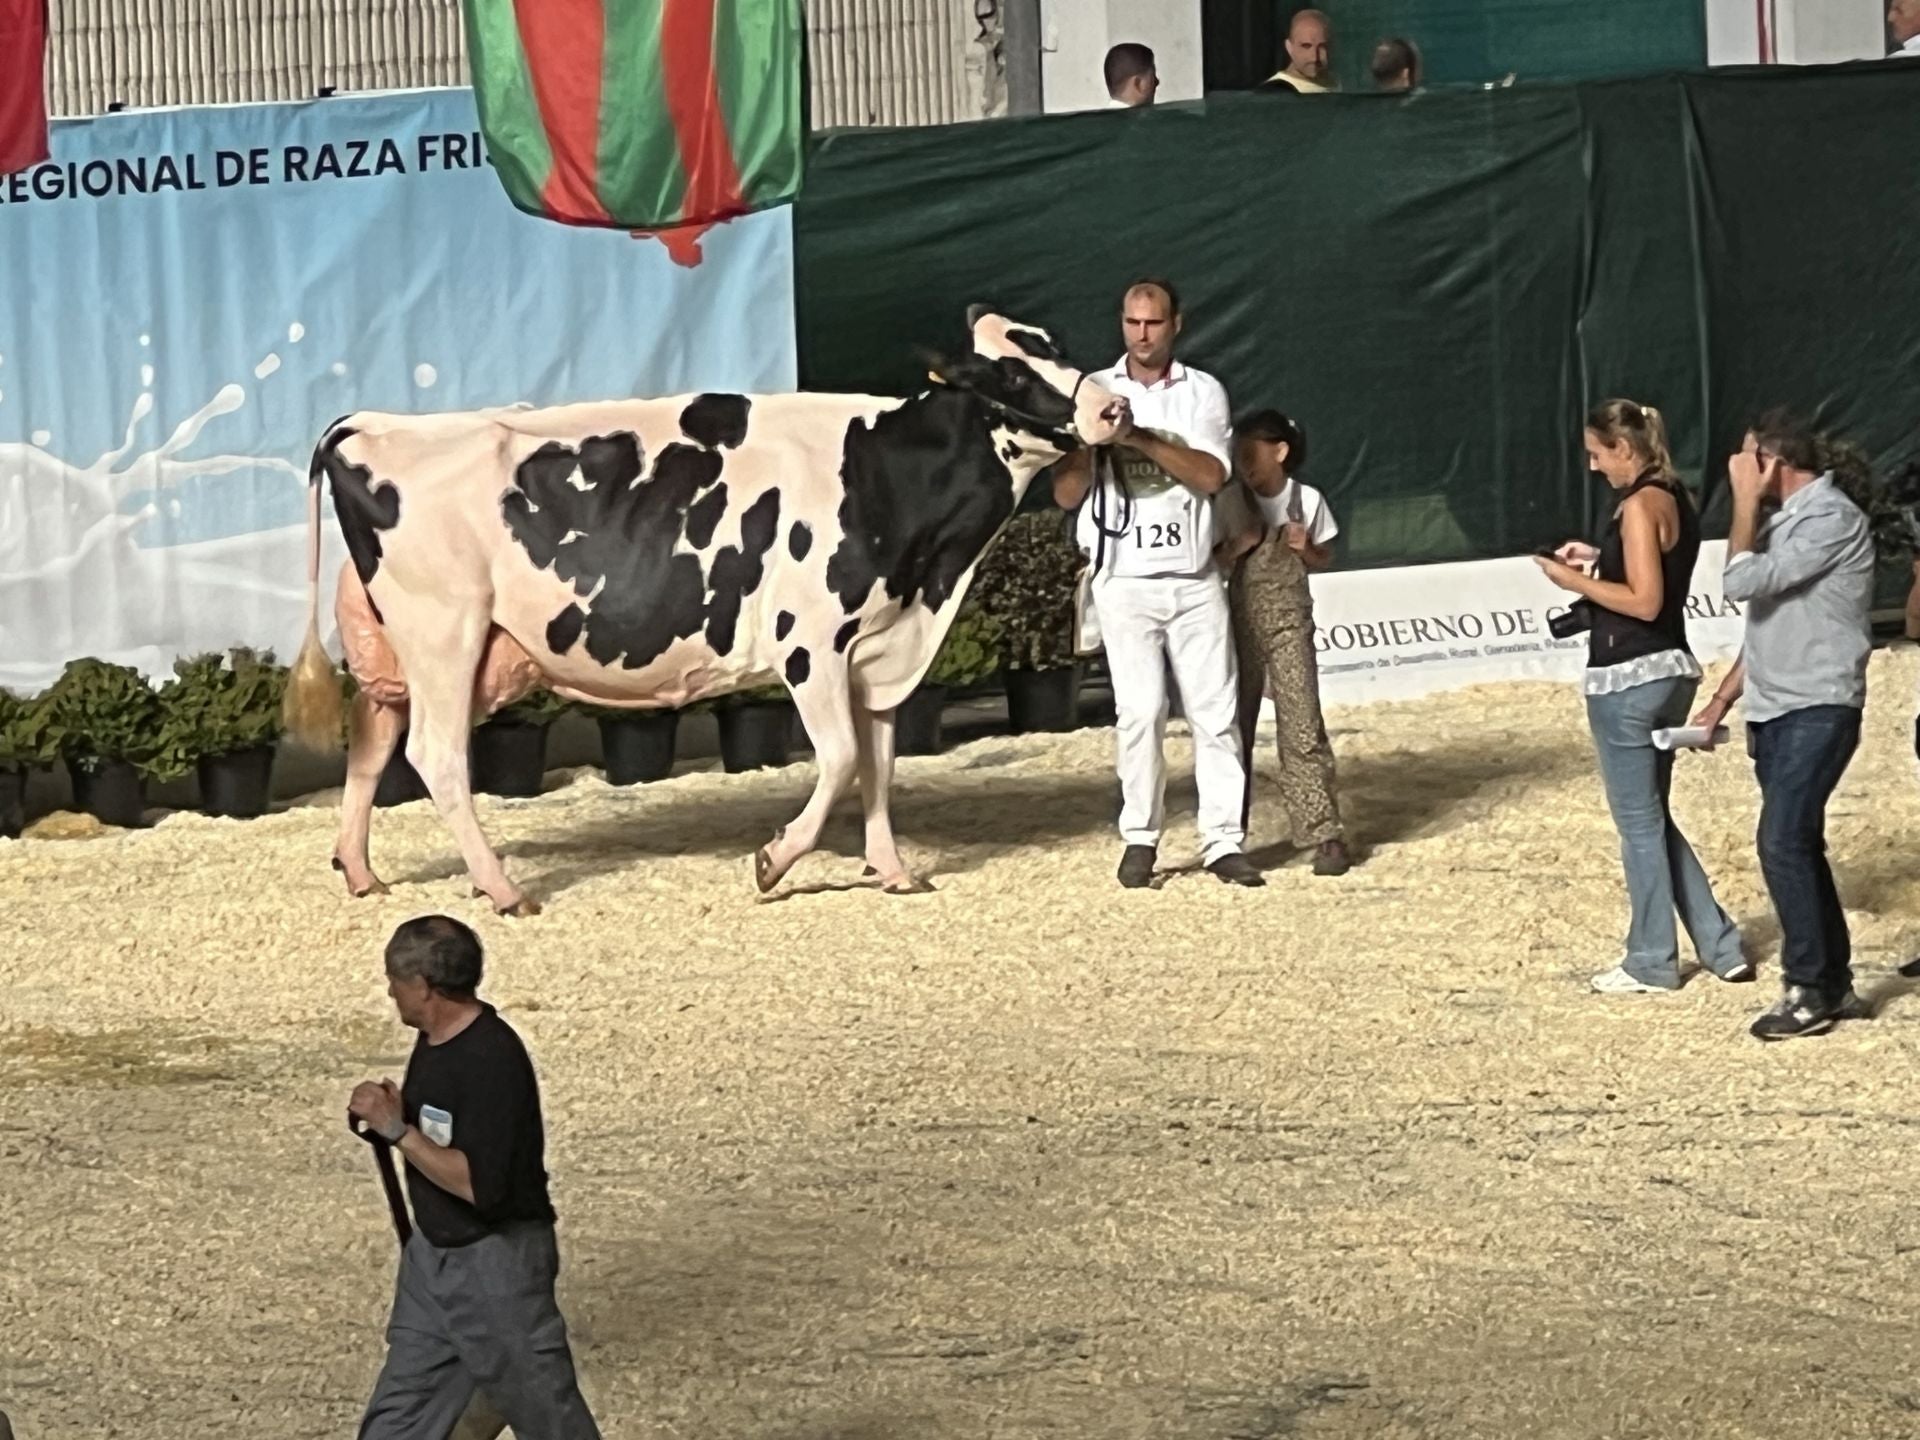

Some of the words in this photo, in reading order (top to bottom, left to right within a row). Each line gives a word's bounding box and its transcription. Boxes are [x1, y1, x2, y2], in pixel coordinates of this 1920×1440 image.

[0, 153, 207, 205] EGIONAL
[216, 148, 270, 187] DE
[283, 138, 406, 182] RAZA
[418, 131, 497, 172] FRI
[1135, 522, 1182, 549] 128
[1490, 609, 1539, 636] DE
